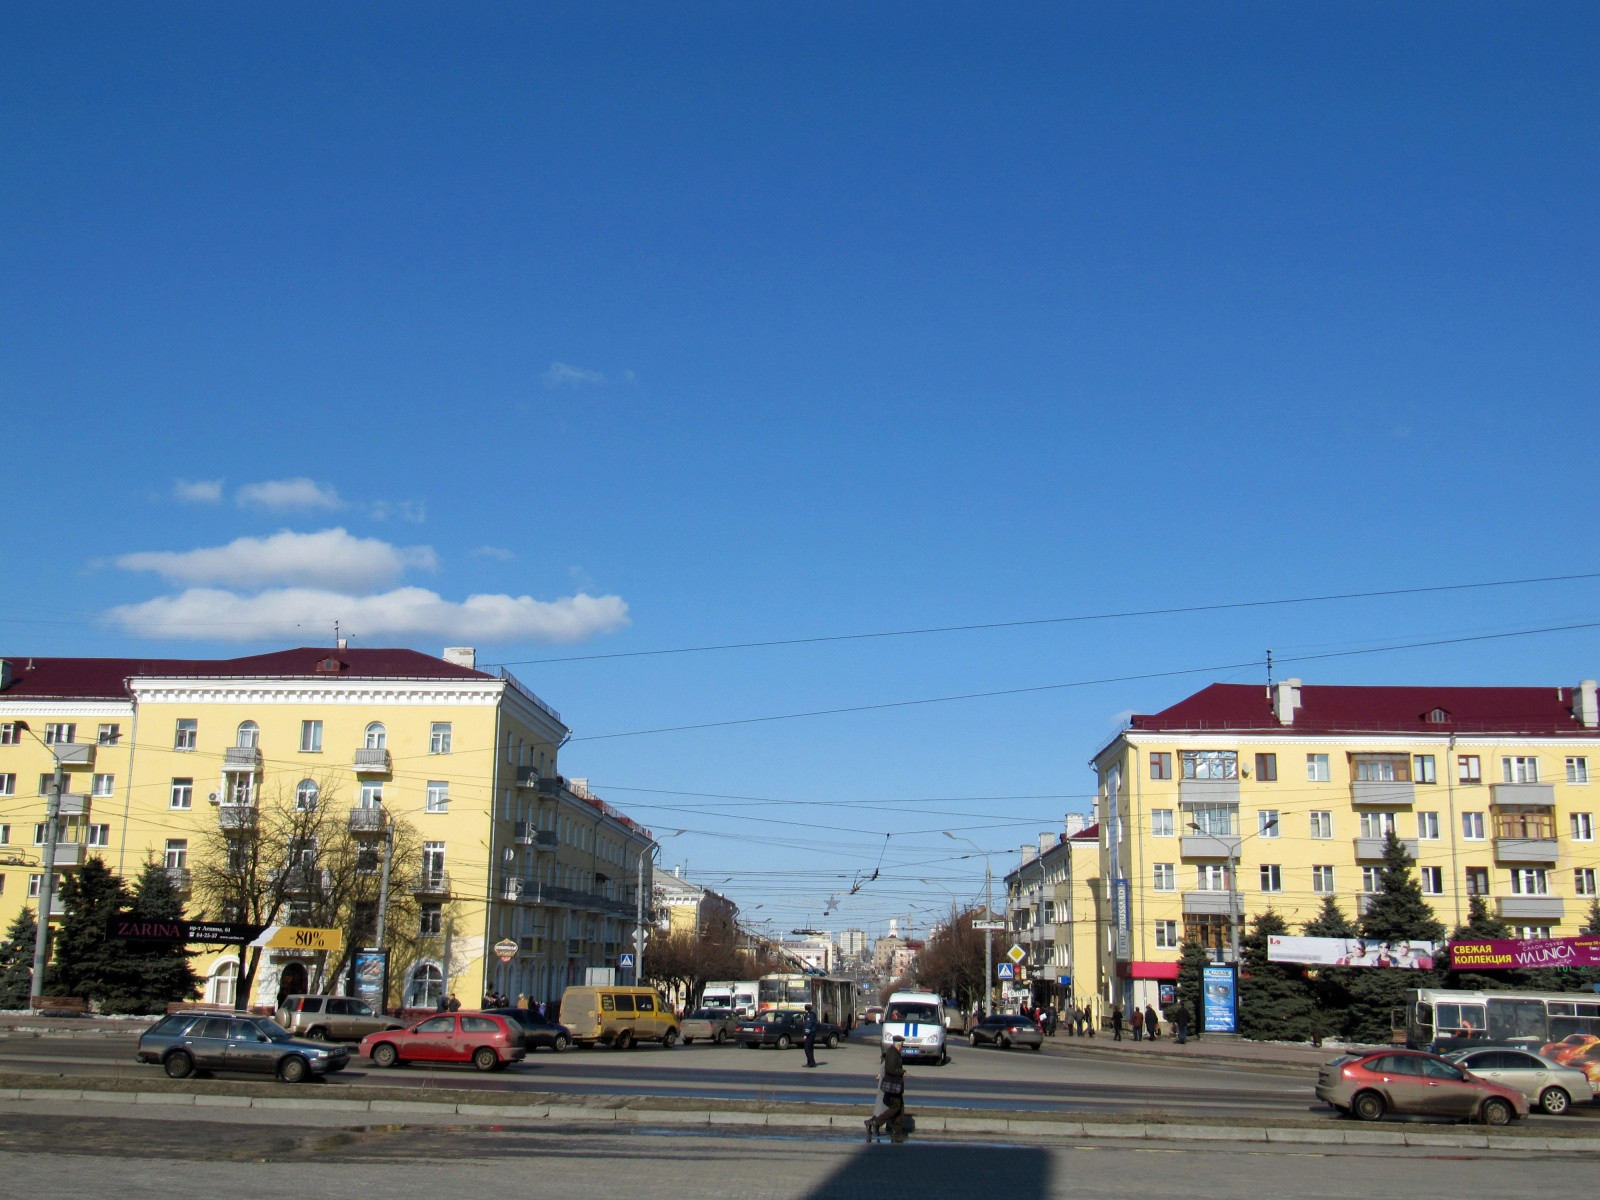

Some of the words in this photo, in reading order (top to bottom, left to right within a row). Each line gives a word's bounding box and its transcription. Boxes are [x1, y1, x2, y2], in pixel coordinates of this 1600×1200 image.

[119, 922, 180, 937] ZARINA
[295, 930, 324, 947] 80%
[1453, 944, 1492, 954] СВЕЖАЯ
[1454, 954, 1512, 965] КОЛЛЕКЦИЯ
